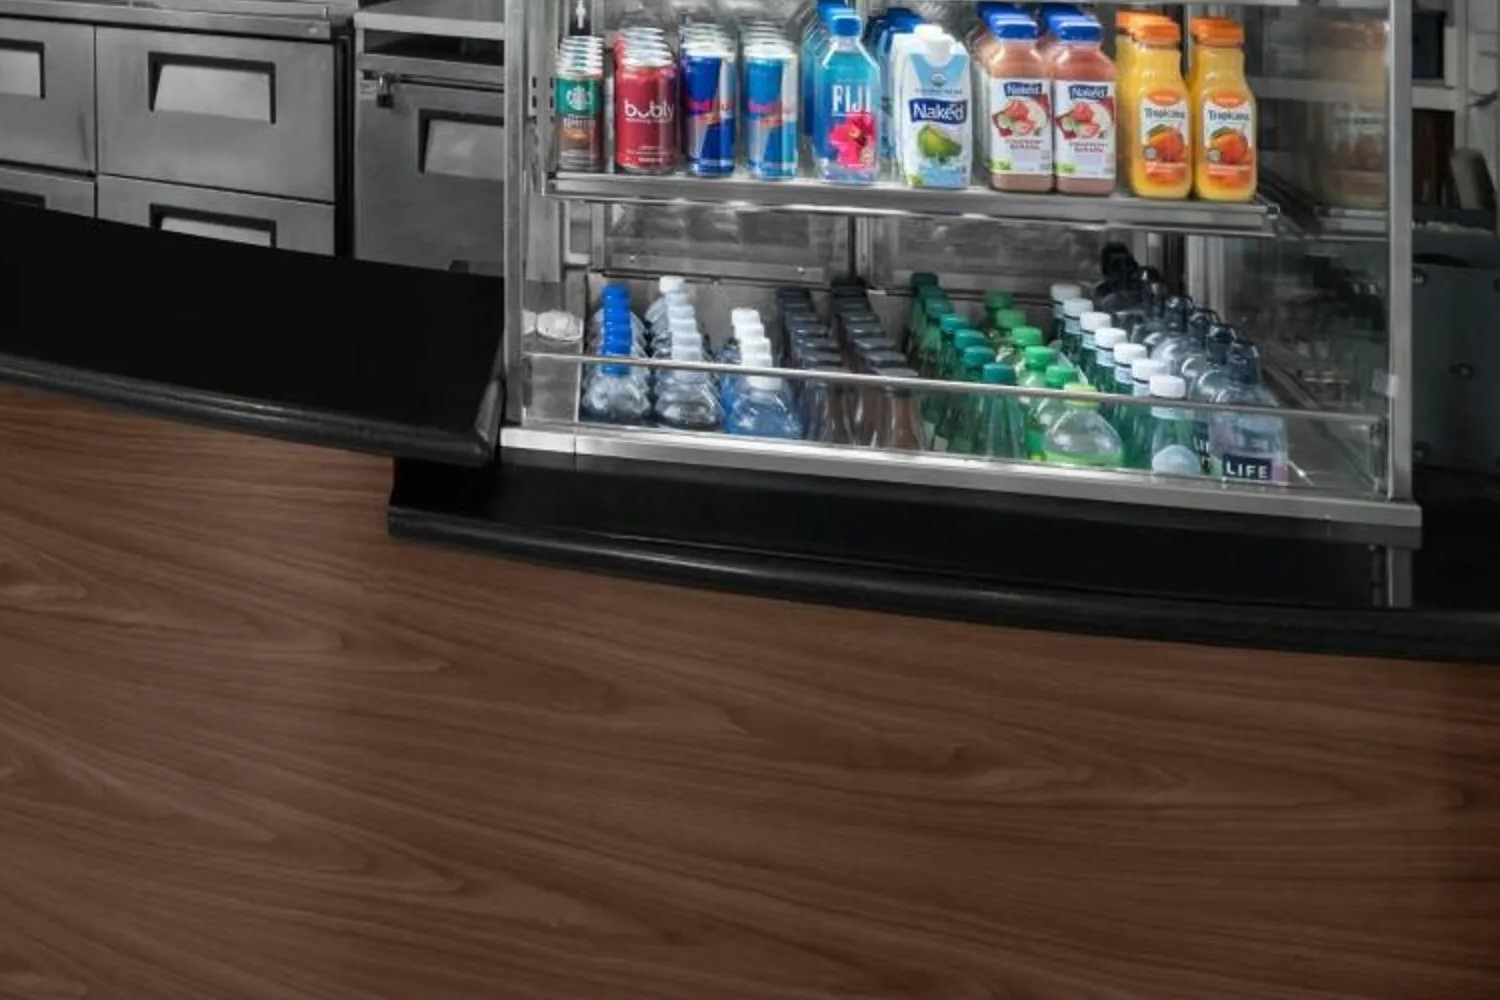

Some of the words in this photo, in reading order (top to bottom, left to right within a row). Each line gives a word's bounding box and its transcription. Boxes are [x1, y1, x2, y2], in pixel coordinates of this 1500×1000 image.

[832, 84, 871, 114] FIJI
[624, 98, 674, 120] bubly
[913, 103, 965, 121] Naked
[1144, 108, 1185, 118] Tropicana
[1207, 109, 1250, 120] Tropicana
[1226, 461, 1269, 479] LIFE
